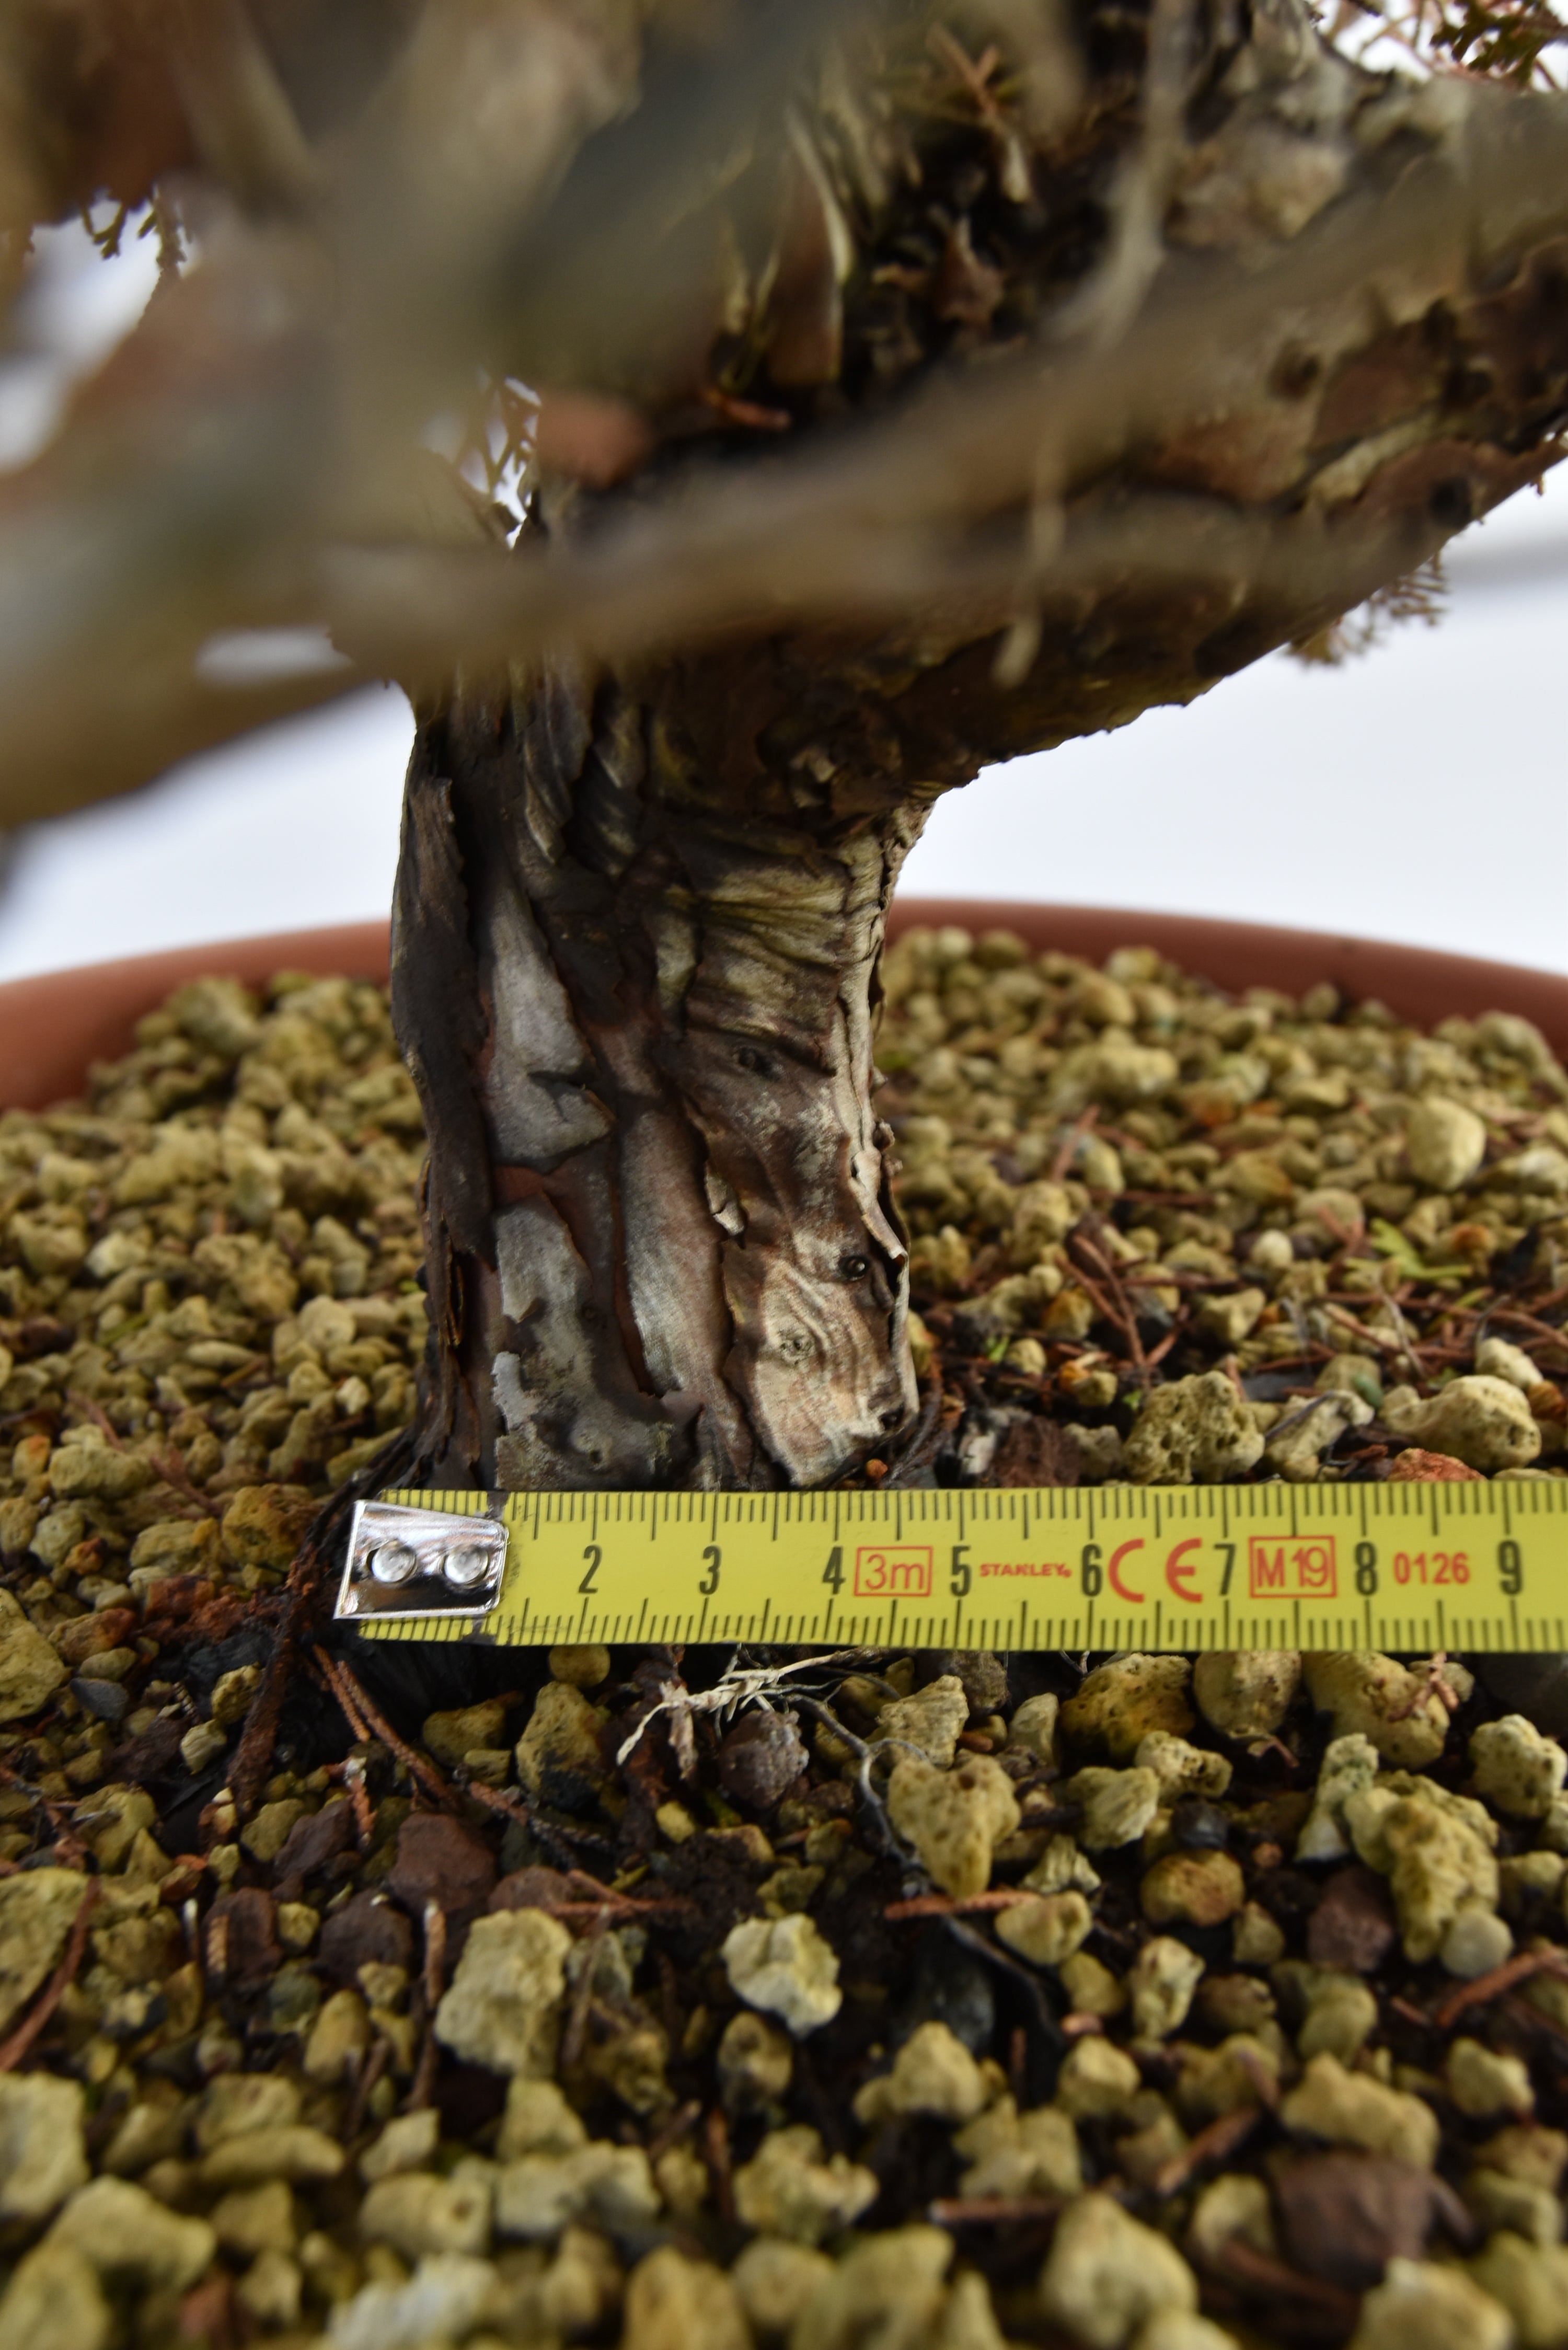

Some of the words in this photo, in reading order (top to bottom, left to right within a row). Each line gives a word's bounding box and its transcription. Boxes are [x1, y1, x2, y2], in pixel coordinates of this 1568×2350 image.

[579, 1545, 602, 1594] 2
[699, 1546, 722, 1595] 3
[823, 1546, 845, 1595] 4
[865, 1554, 926, 1589] 3m
[950, 1546, 971, 1596] 5
[1081, 1543, 1102, 1597] 6
[1214, 1543, 1236, 1595] 7
[1354, 1541, 1378, 1596] 8
[1394, 1552, 1470, 1584] 0126
[1497, 1540, 1523, 1595] 9
